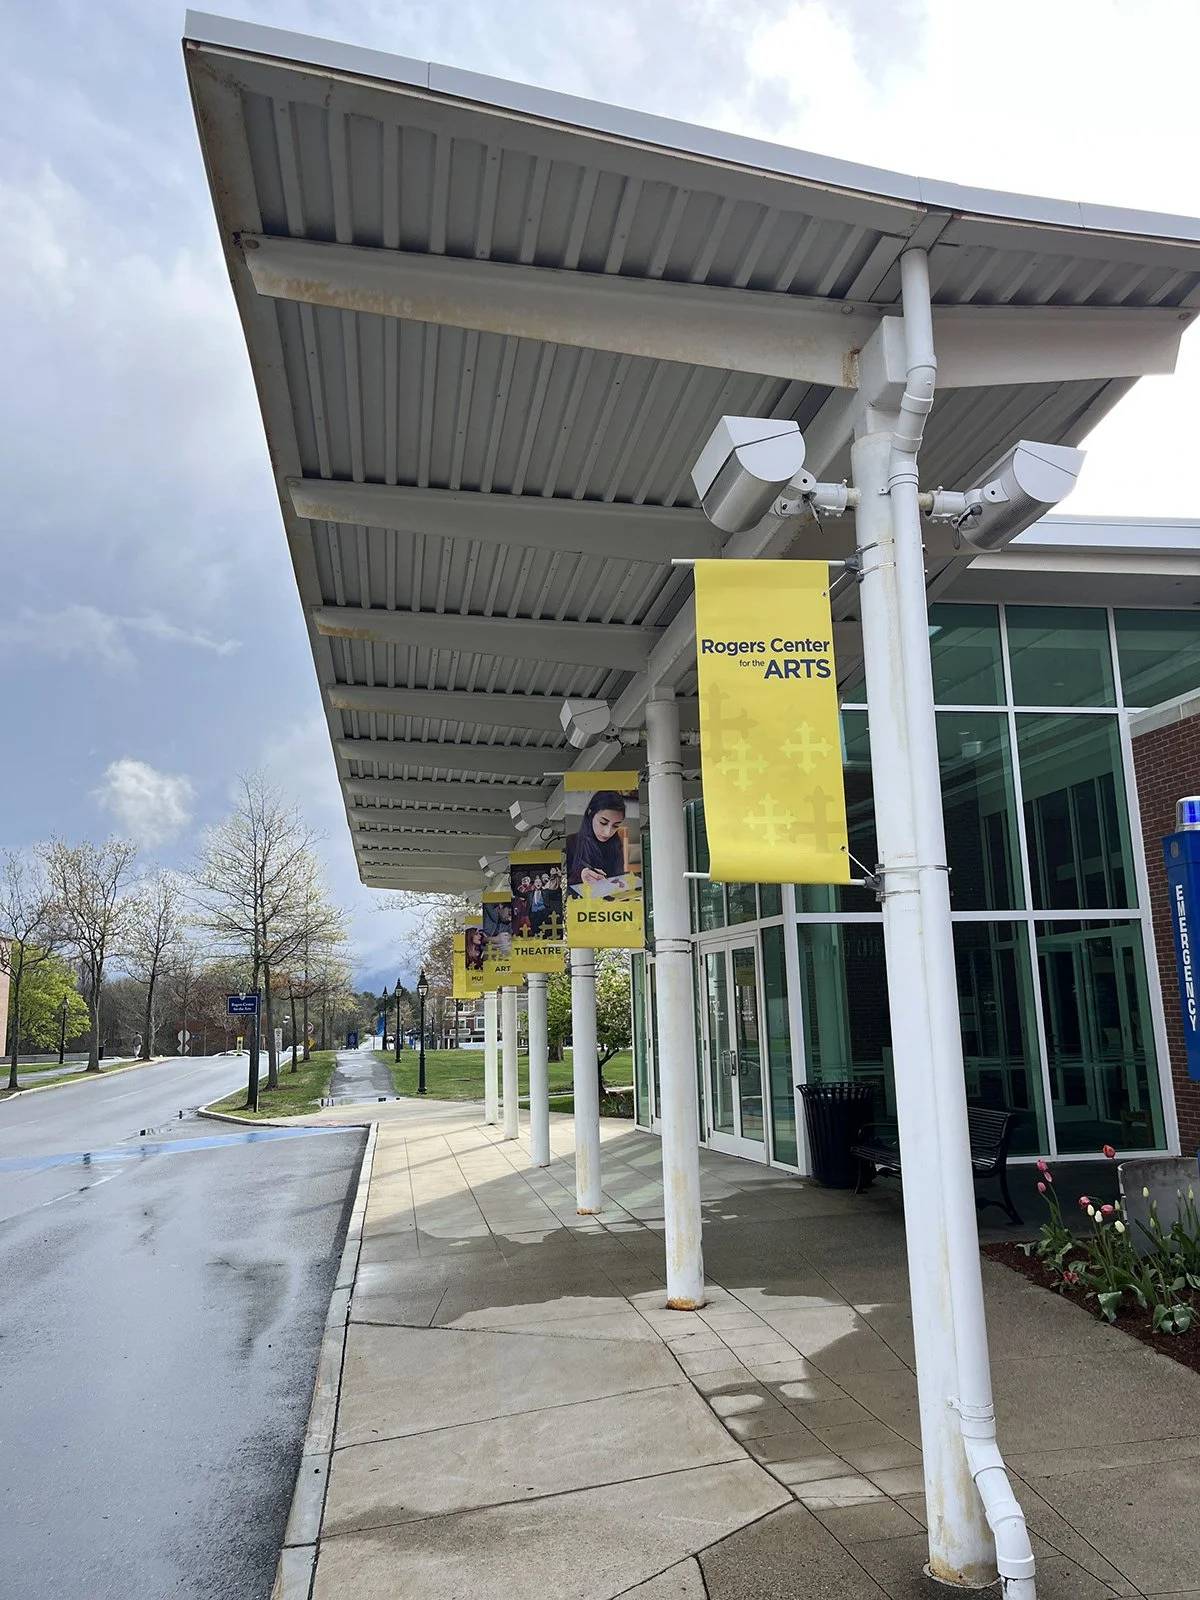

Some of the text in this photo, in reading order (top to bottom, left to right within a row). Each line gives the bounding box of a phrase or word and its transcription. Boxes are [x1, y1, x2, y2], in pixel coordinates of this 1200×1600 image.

[701, 637, 830, 656] Rogers Center
[739, 659, 831, 679] for the ARTS
[577, 910, 633, 923] DESIGN
[514, 946, 562, 956] THEATRE
[1175, 884, 1197, 1032] EMERGENCY
[495, 965, 511, 973] ART
